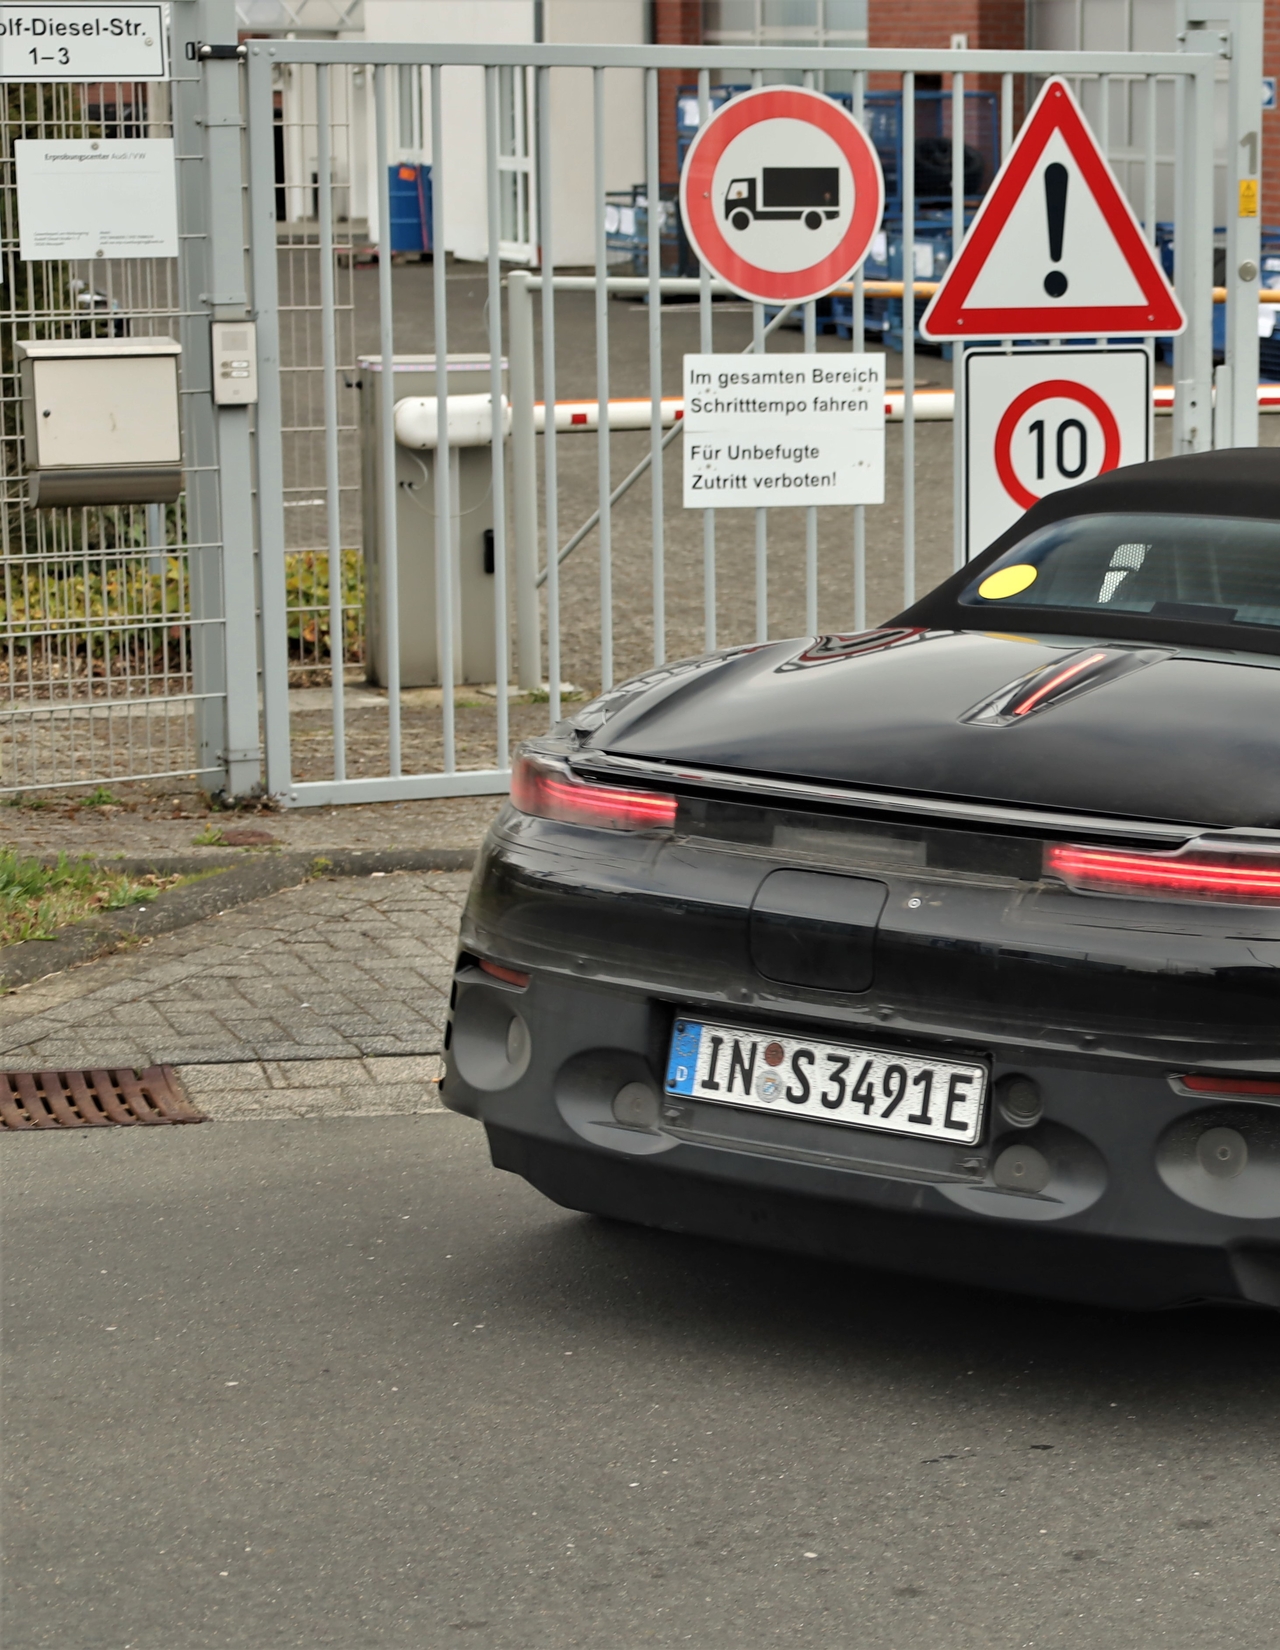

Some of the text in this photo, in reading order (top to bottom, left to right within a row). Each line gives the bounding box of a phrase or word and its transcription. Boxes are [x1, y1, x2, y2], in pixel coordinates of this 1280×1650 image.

[1240, 131, 1258, 175] 1
[690, 368, 879, 389] Im gesamten Bereich
[690, 397, 868, 416] Schritttempo fahren
[691, 444, 820, 463] Für Unbefugte
[1028, 418, 1088, 480] 10
[691, 472, 837, 490] Zutritt verboten!
[676, 1066, 688, 1082] D
